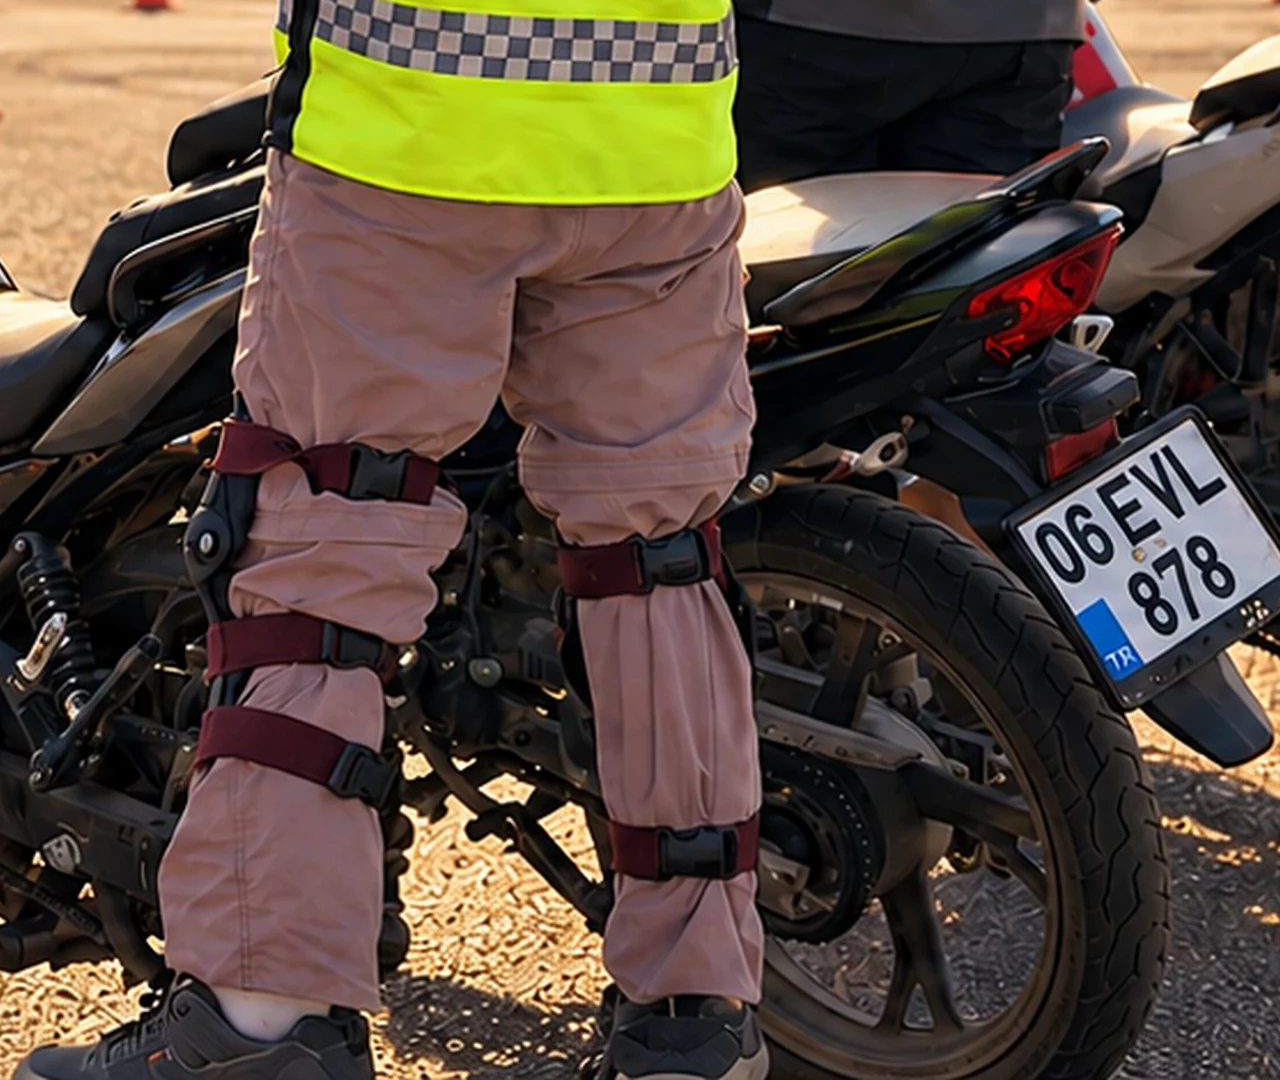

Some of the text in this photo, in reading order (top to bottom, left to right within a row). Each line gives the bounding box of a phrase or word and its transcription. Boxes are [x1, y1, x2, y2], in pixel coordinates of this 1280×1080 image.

[1035, 445, 1227, 584] 06 EVL
[1128, 535, 1236, 637] 878
[1104, 646, 1138, 671] TR
